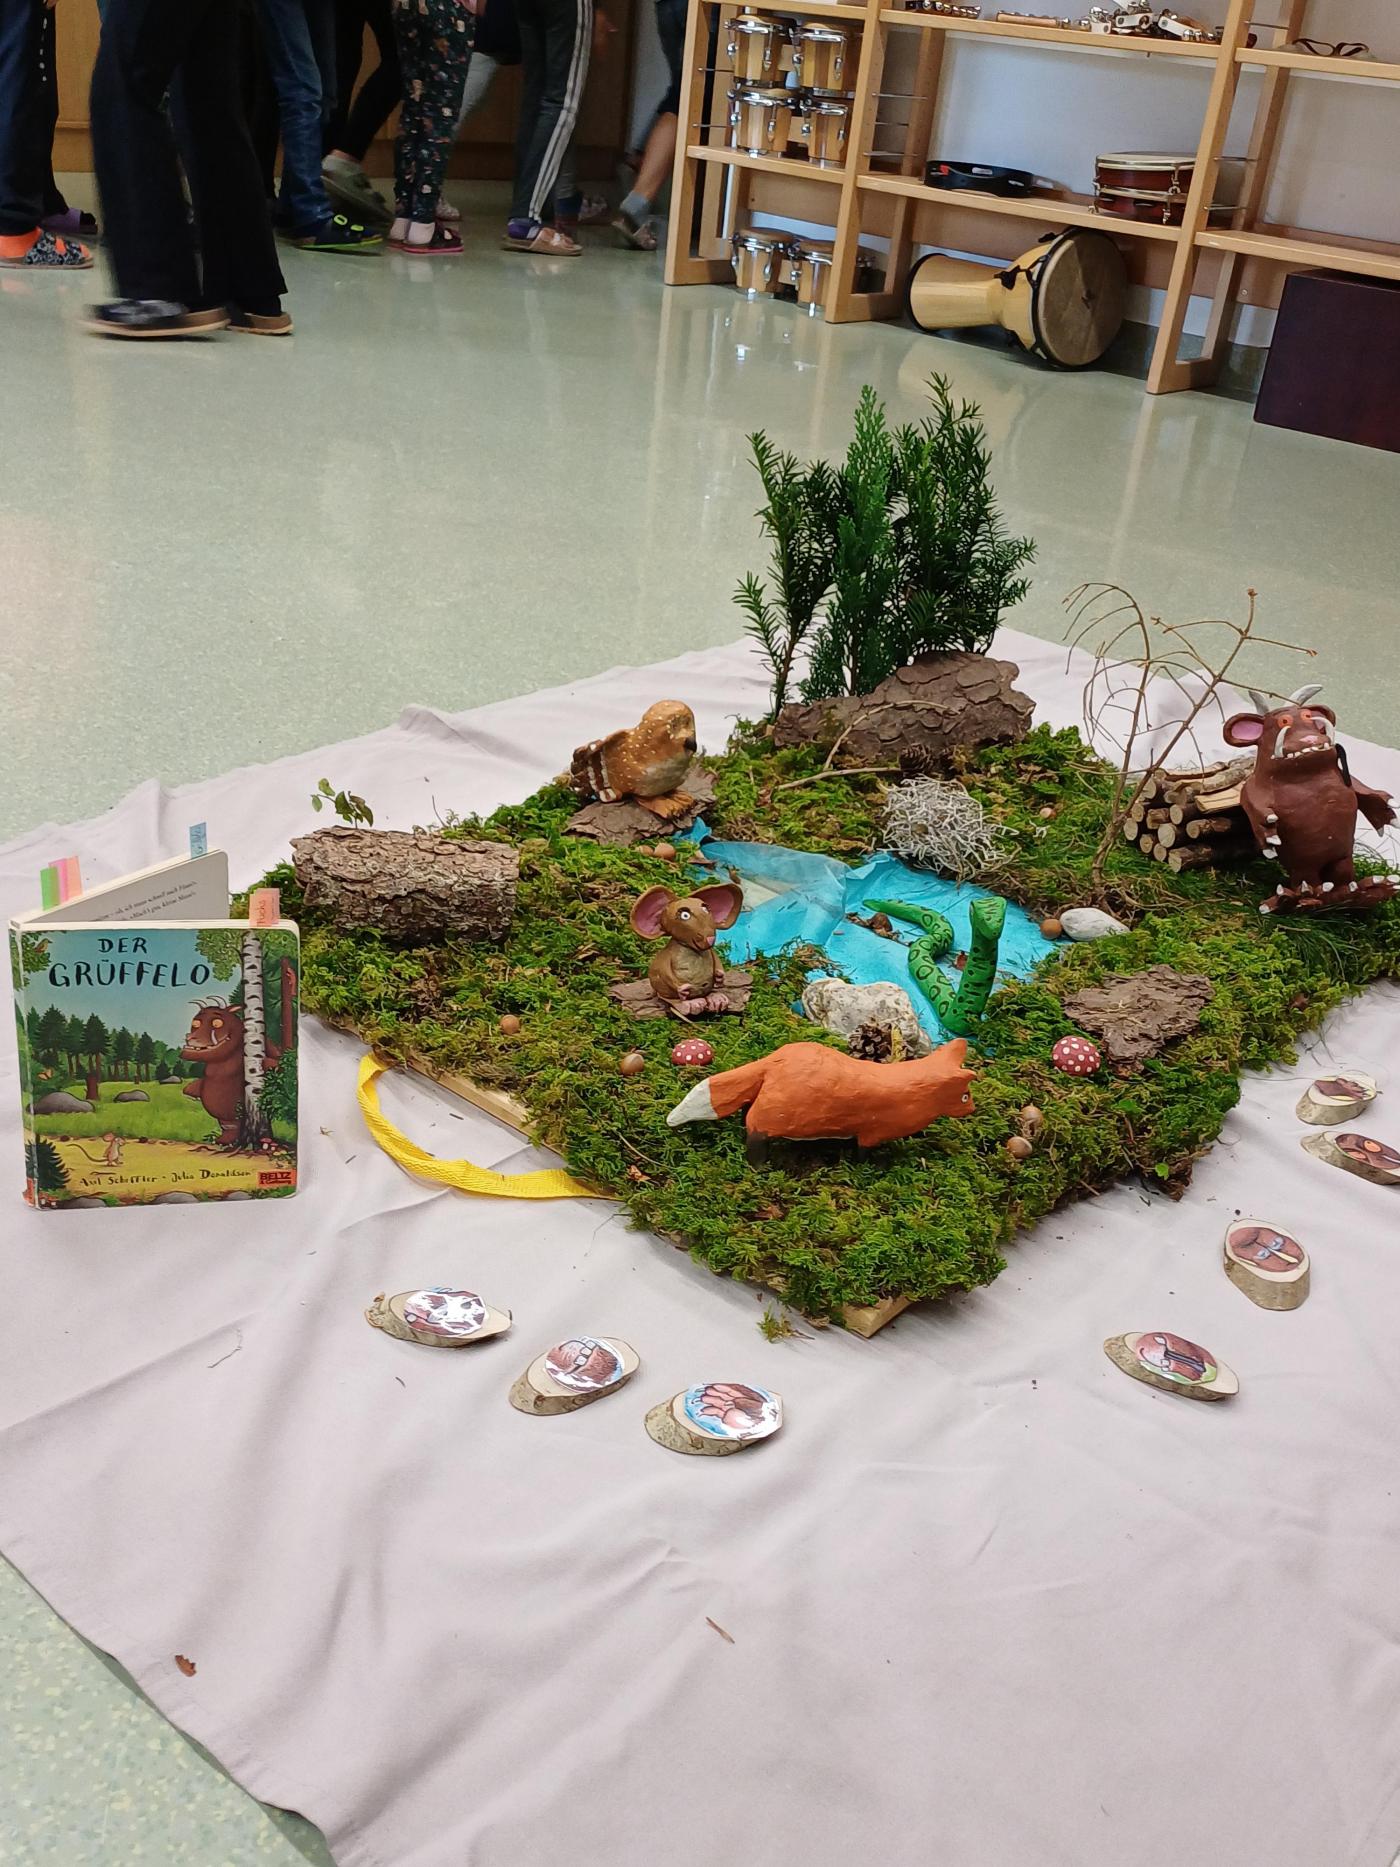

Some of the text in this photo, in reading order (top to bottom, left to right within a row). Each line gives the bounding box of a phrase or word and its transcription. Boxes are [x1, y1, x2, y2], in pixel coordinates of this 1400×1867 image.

[98, 937, 147, 954] DER
[50, 959, 210, 988] GRÜFFELO
[259, 1171, 292, 1180] BELTZ
